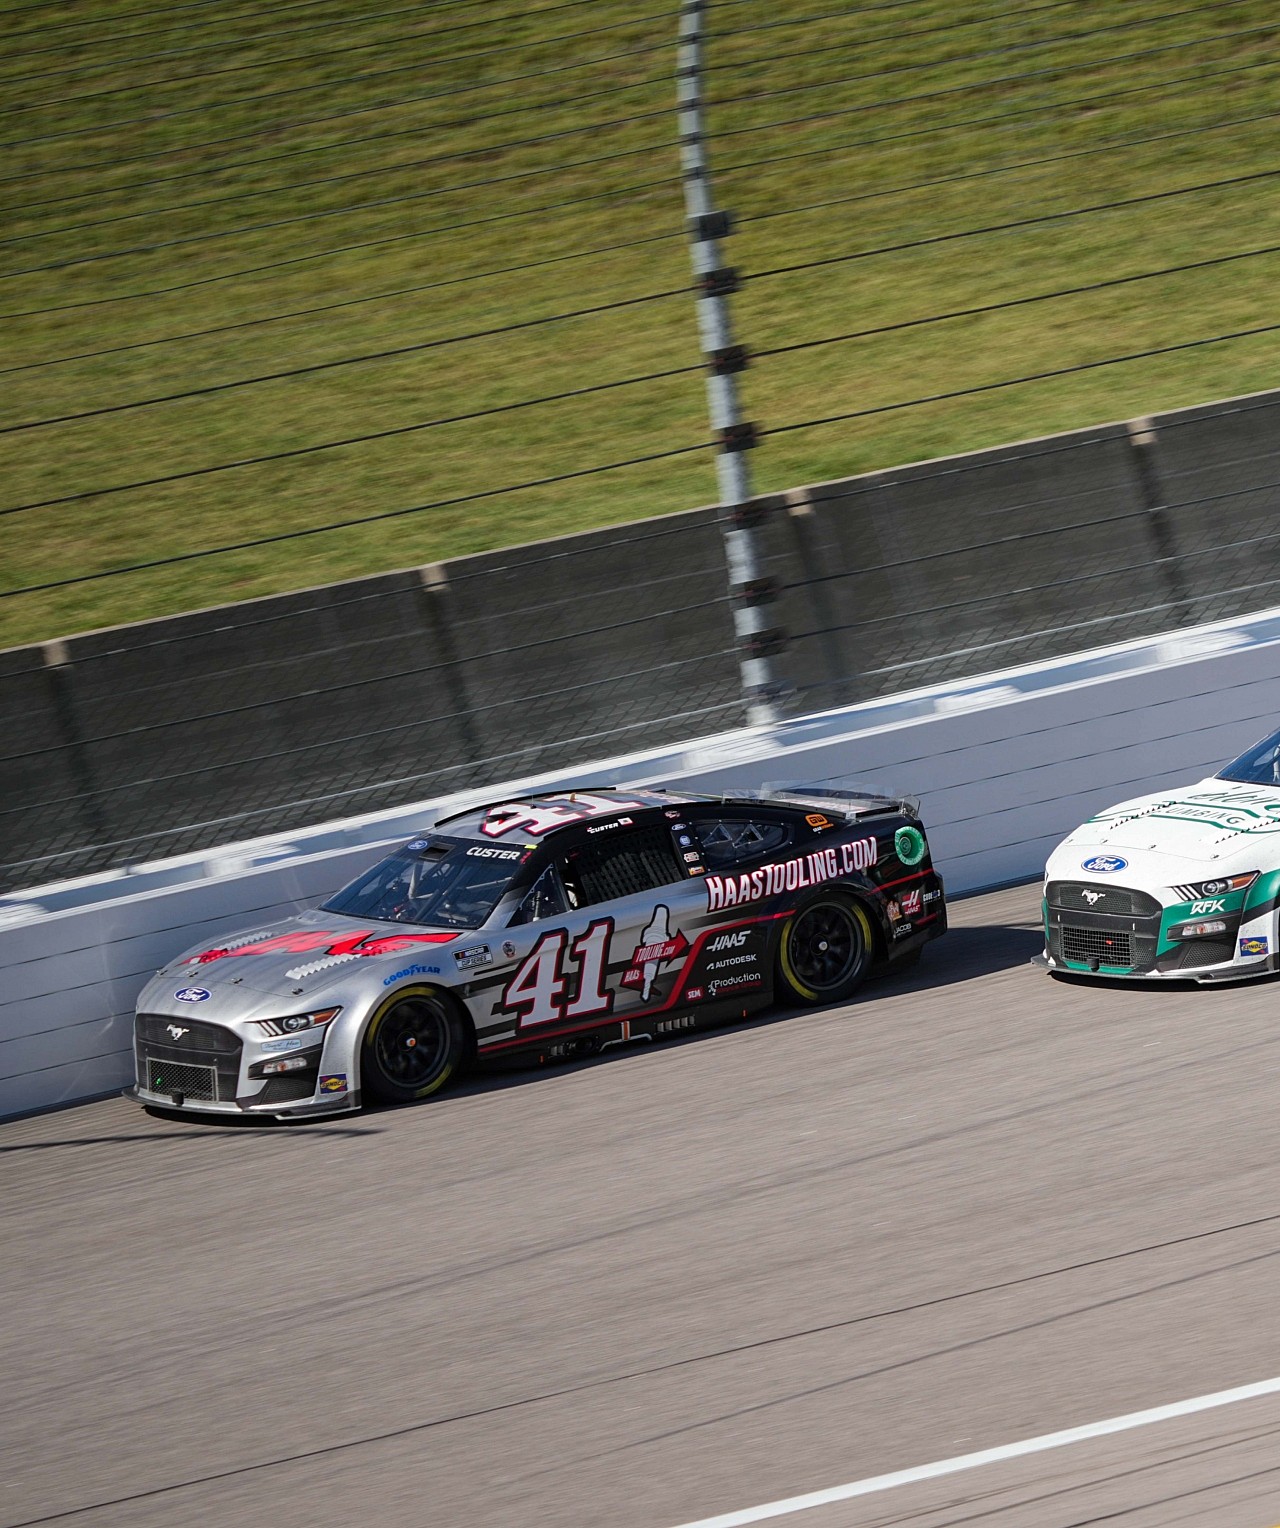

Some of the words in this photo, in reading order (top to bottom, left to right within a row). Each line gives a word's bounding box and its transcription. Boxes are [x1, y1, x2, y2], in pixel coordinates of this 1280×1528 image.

[590, 822, 619, 834] CUSTER
[466, 846, 521, 860] CUSTER
[1086, 855, 1121, 872] Ford
[1190, 899, 1226, 915] RFK
[706, 930, 752, 951] HAAS
[715, 954, 757, 968] AUTODESK
[383, 964, 441, 987] GOODYEAR
[503, 919, 612, 1030] 41
[714, 972, 761, 988] Production
